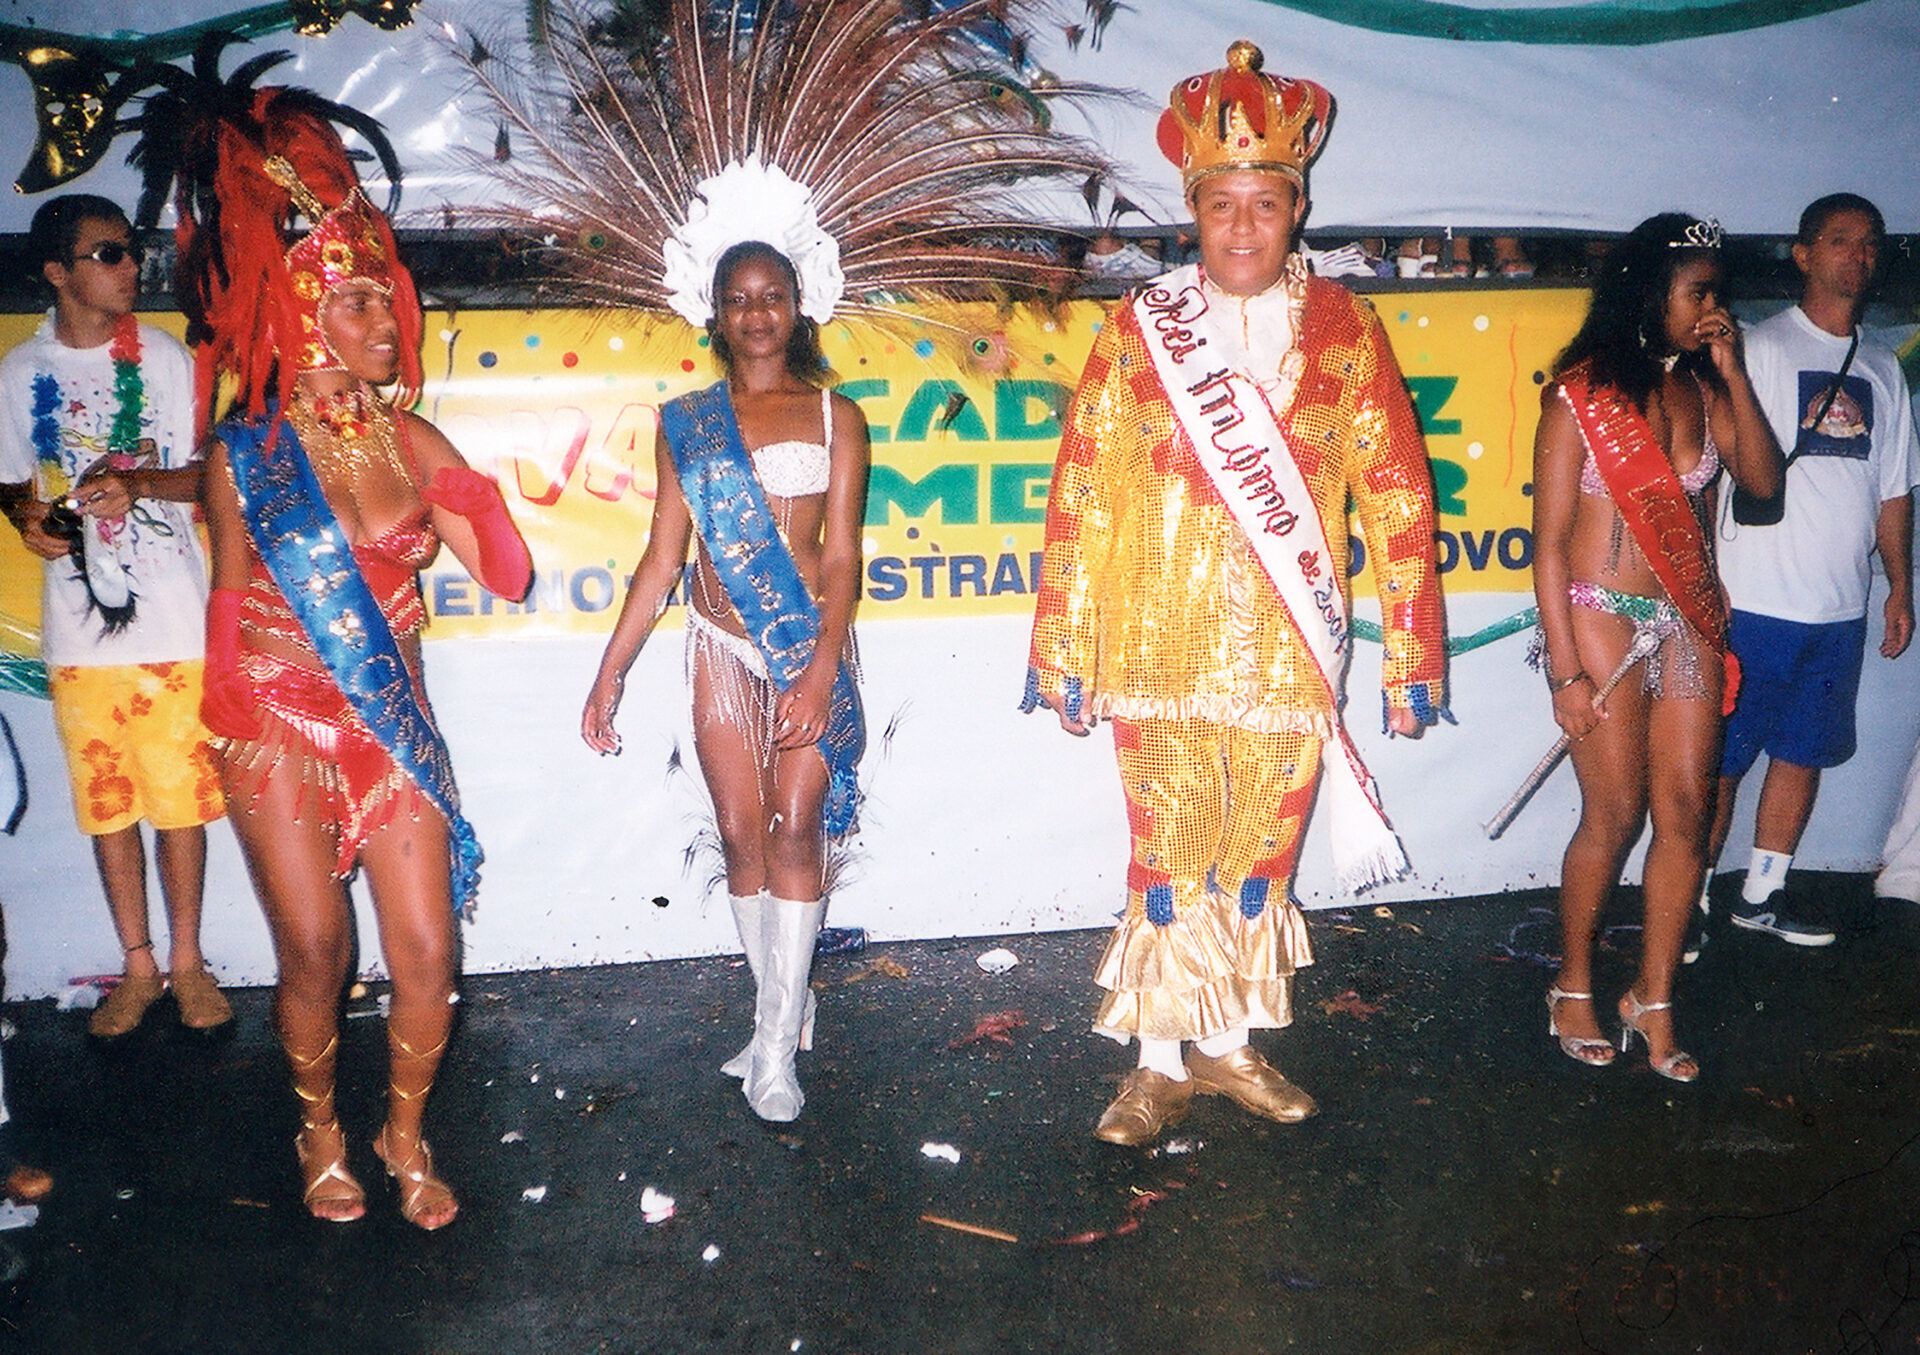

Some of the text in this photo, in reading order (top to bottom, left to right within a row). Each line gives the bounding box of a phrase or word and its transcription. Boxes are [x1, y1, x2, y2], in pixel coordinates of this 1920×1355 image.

[838, 379, 1073, 442] CAD
[1143, 285, 1210, 365] Rei
[1297, 549, 1322, 587] de
[866, 551, 1044, 601] STRA
[1437, 526, 1534, 574] OVO
